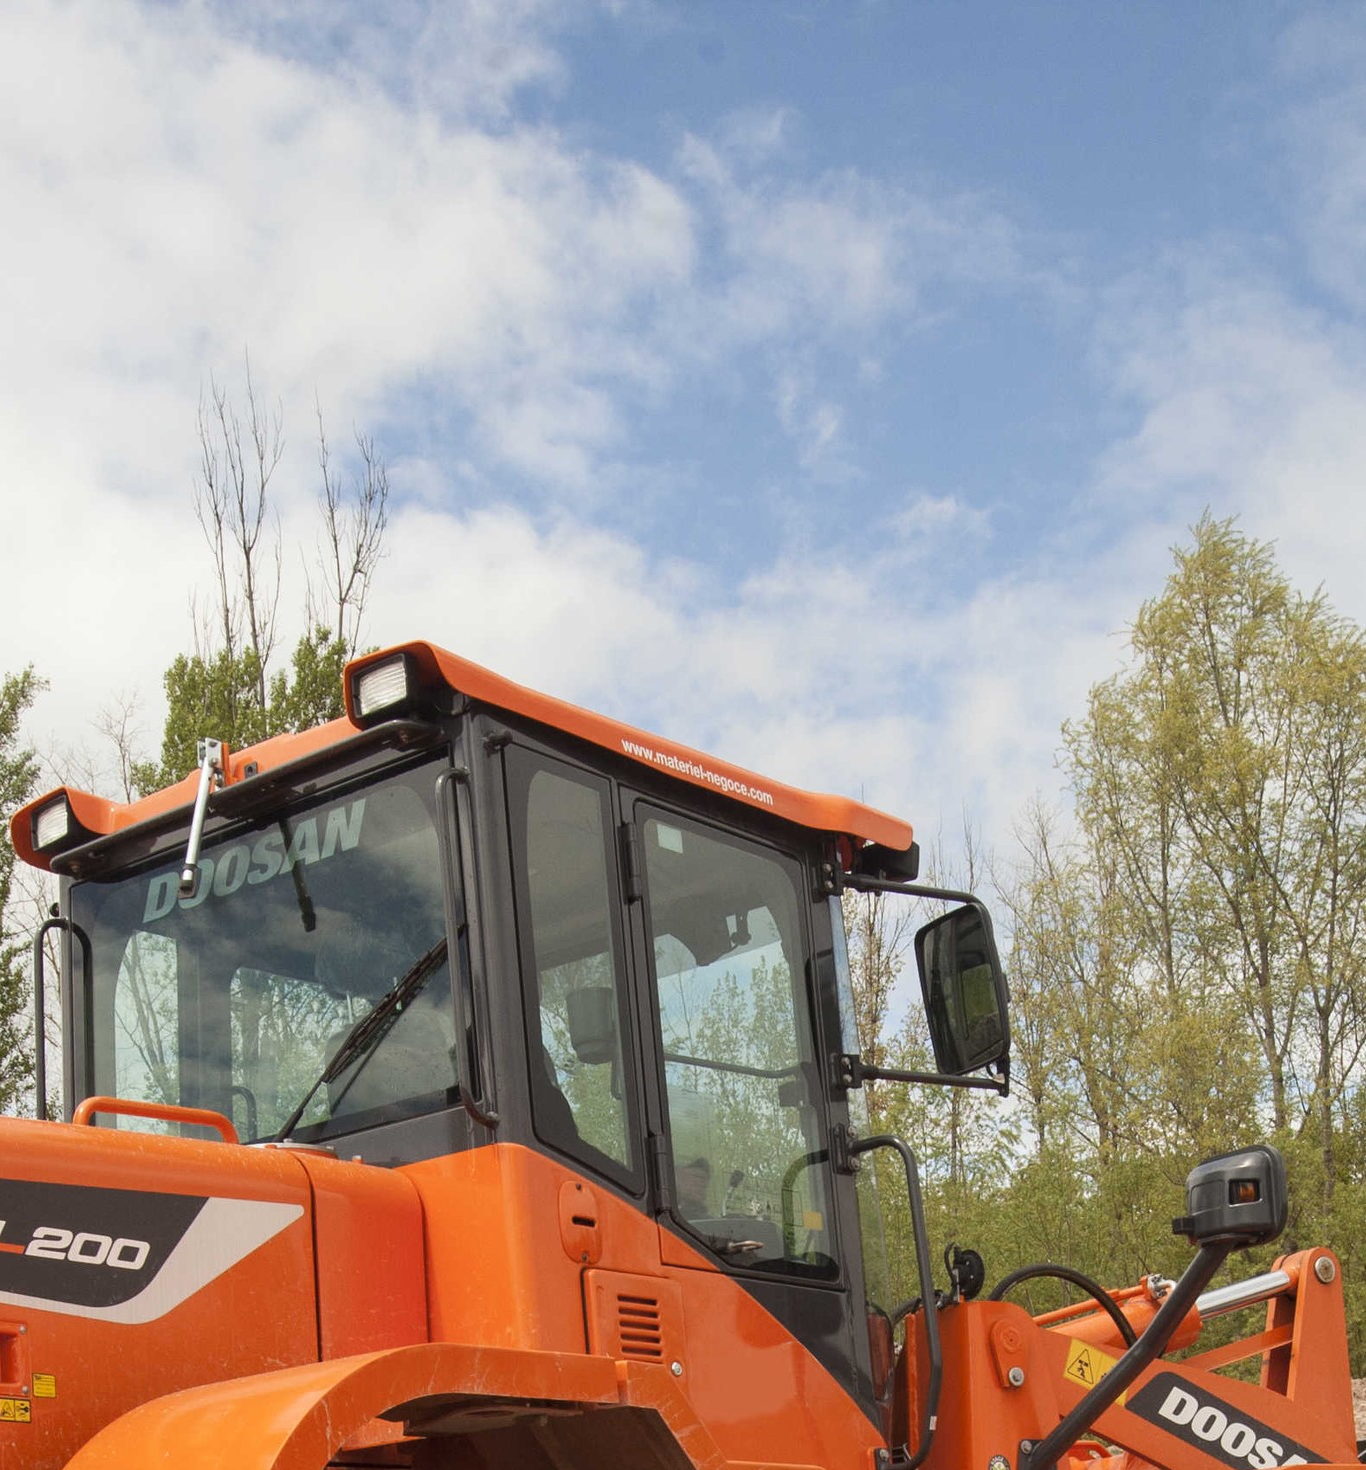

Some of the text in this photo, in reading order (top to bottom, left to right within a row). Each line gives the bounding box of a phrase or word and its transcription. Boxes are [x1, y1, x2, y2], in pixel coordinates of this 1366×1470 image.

[621, 738, 774, 806] www.materiel-negoce.com
[142, 798, 367, 924] DOOSAN
[1158, 1386, 1308, 1470] DOOS
